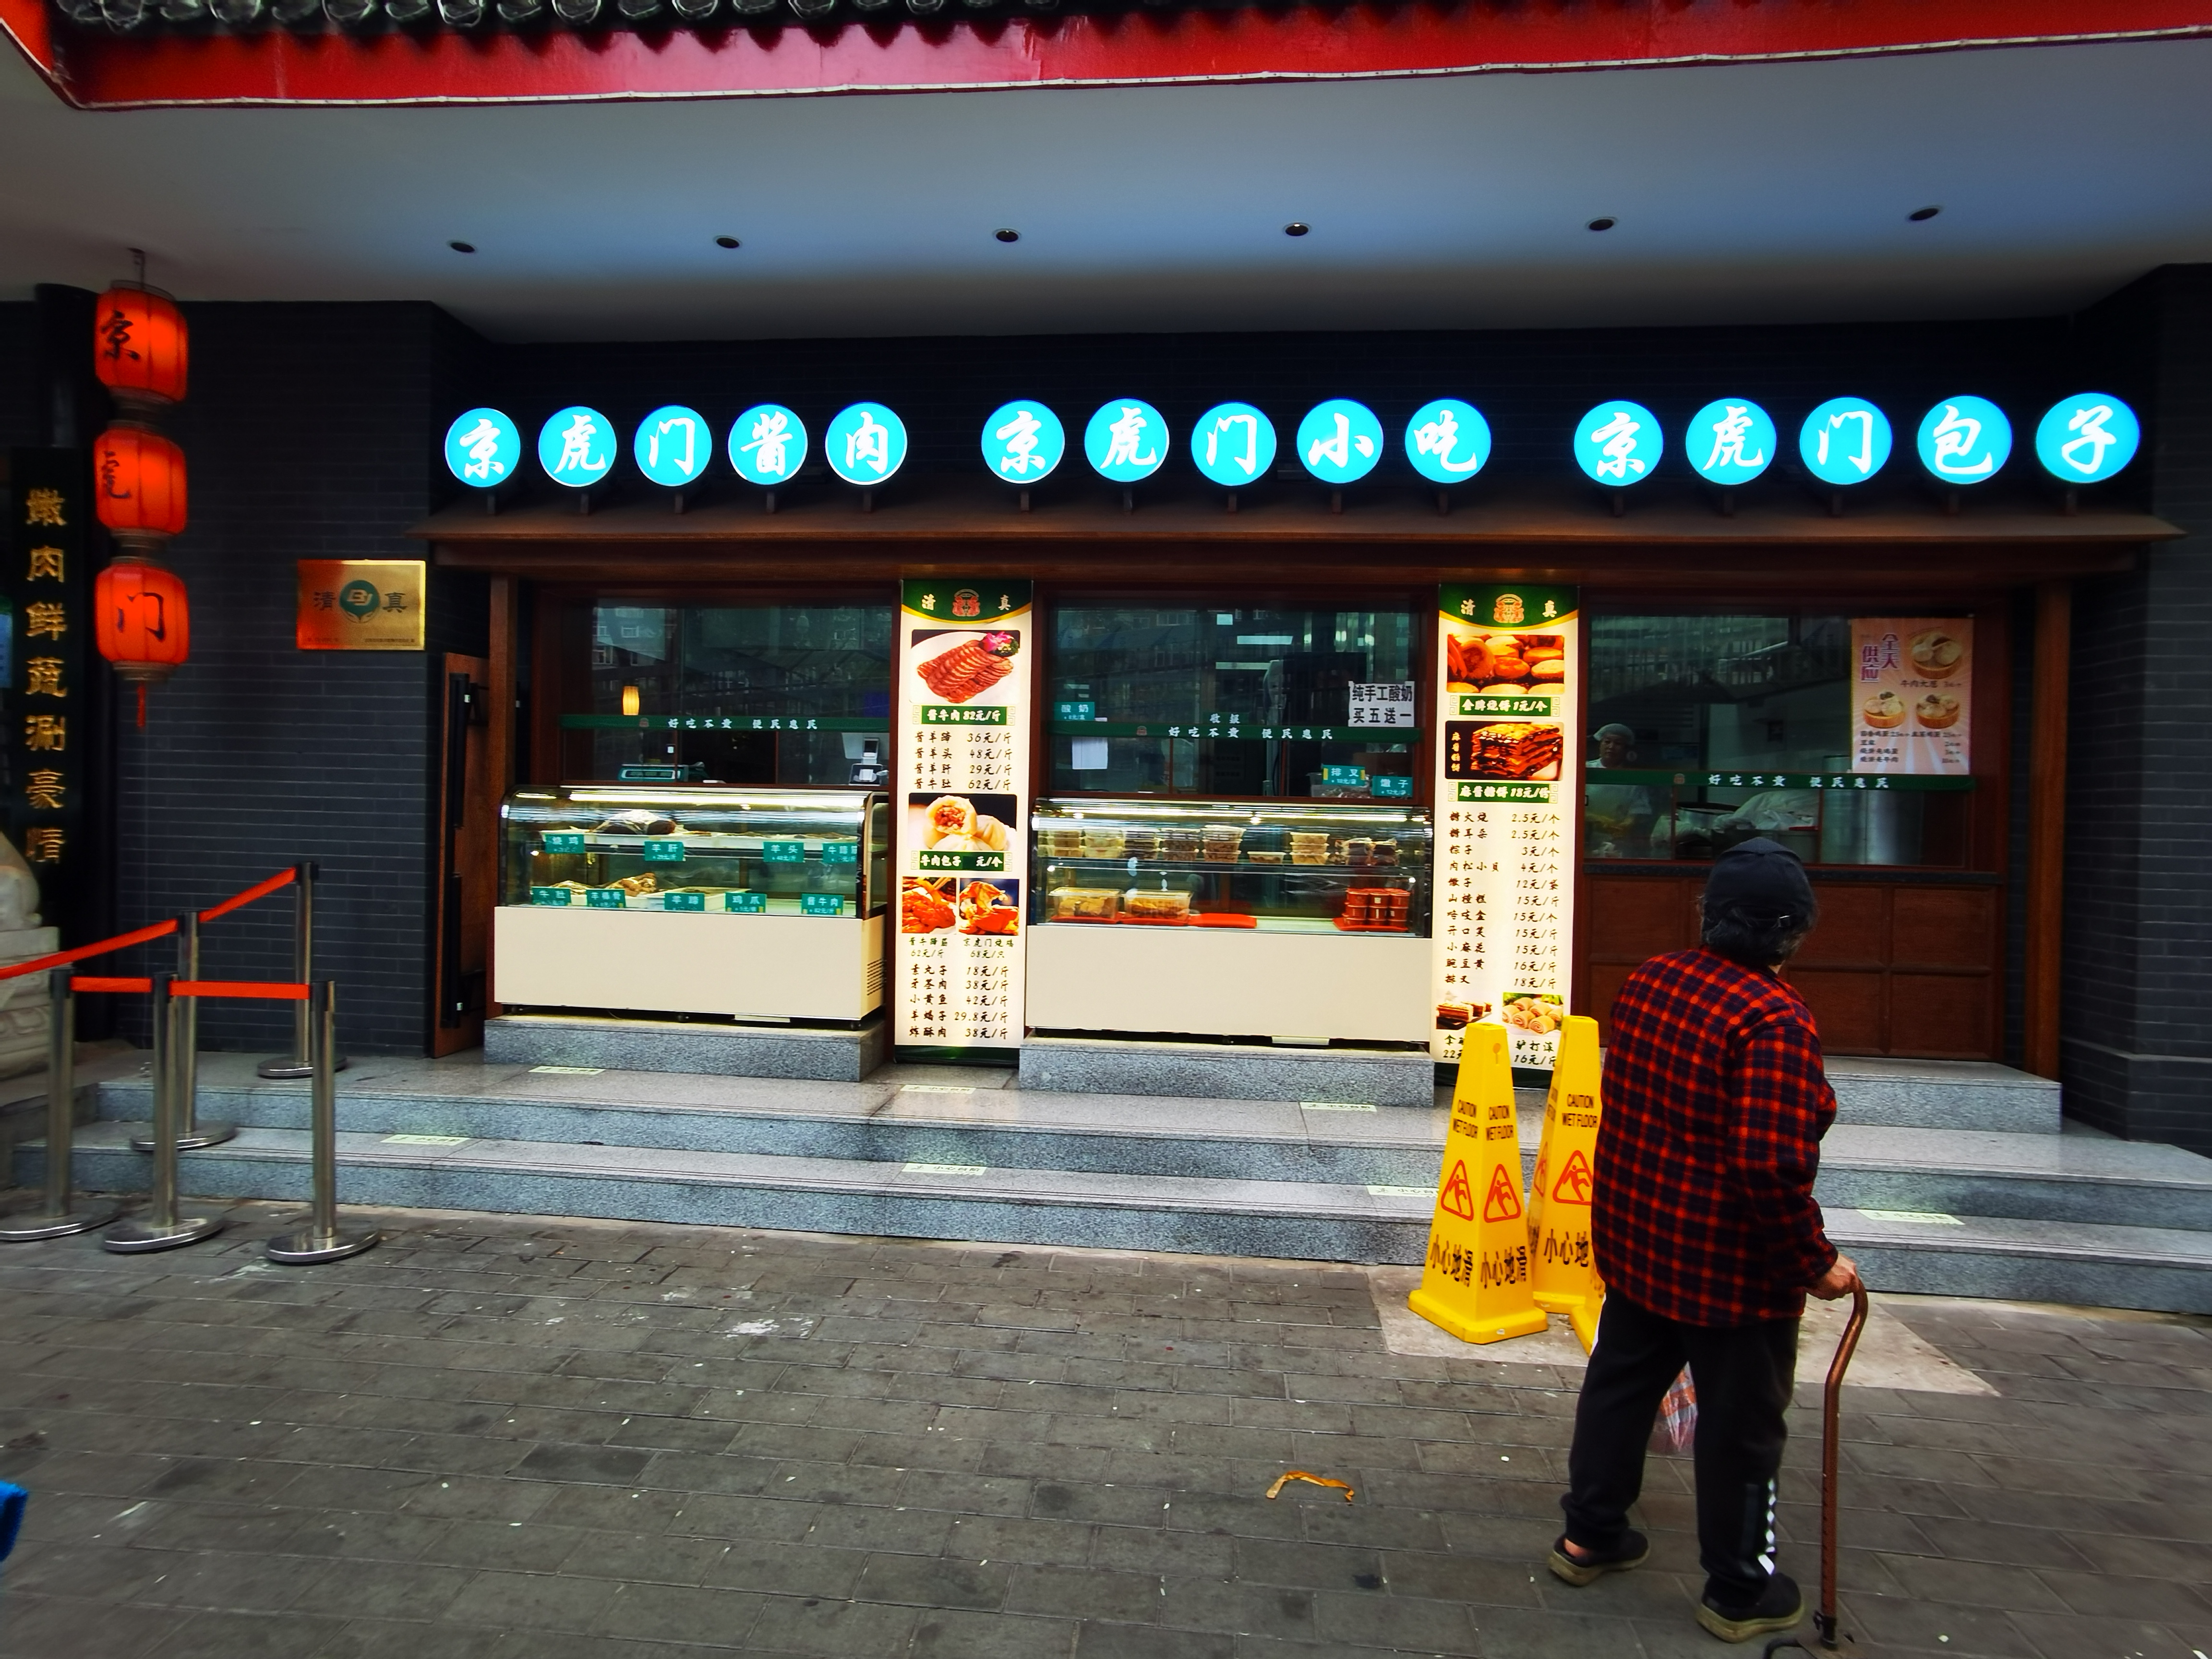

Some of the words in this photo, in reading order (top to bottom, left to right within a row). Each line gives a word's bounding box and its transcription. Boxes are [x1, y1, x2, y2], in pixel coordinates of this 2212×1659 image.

[459, 412, 888, 479] 京虎门酱肉
[996, 407, 1477, 475] 京虎门小吃
[1591, 405, 2116, 478] 京虎门包子
[1352, 685, 1412, 702] 纯手工酸奶
[1353, 707, 1412, 724] 买五送一
[668, 718, 733, 729] 好吃不贵
[1168, 727, 1239, 738] 好吃不贵
[915, 747, 952, 759] 酱羊头
[969, 748, 1012, 760] 48元/斤
[969, 764, 1012, 776] 29元/斤
[968, 779, 1011, 791] 62元/斤
[1511, 813, 1560, 824] 2.5元/个
[1511, 830, 1560, 841] 2.5元/个
[770, 844, 798, 853] 羊头
[1521, 846, 1560, 857] 3元/个
[920, 854, 962, 866] 牛肉包子
[1521, 863, 1558, 874] 4元/个
[1517, 896, 1559, 907] 15元/斤
[1514, 912, 1558, 923] 15元/个
[1515, 928, 1558, 940] 15元/斤
[1515, 945, 1558, 957] 15元/斤
[911, 963, 948, 975] 素丸子
[966, 965, 1009, 978] 18元/斤
[1514, 961, 1557, 973] 16元/斤
[965, 980, 1009, 992] 38元/斤
[1514, 977, 1556, 989] 18元/斤
[910, 993, 948, 1005] 小黄鱼
[966, 995, 1008, 1007] 42元/斤
[954, 1011, 1008, 1023] 29.8元/斤
[965, 1027, 1008, 1040] 38元/斤
[1567, 1094, 1594, 1108] CAUTION
[1544, 1228, 1589, 1267] 小心地
[1430, 1234, 1473, 1287] 小心地滑
[1481, 1246, 1527, 1289] 小心地滑
